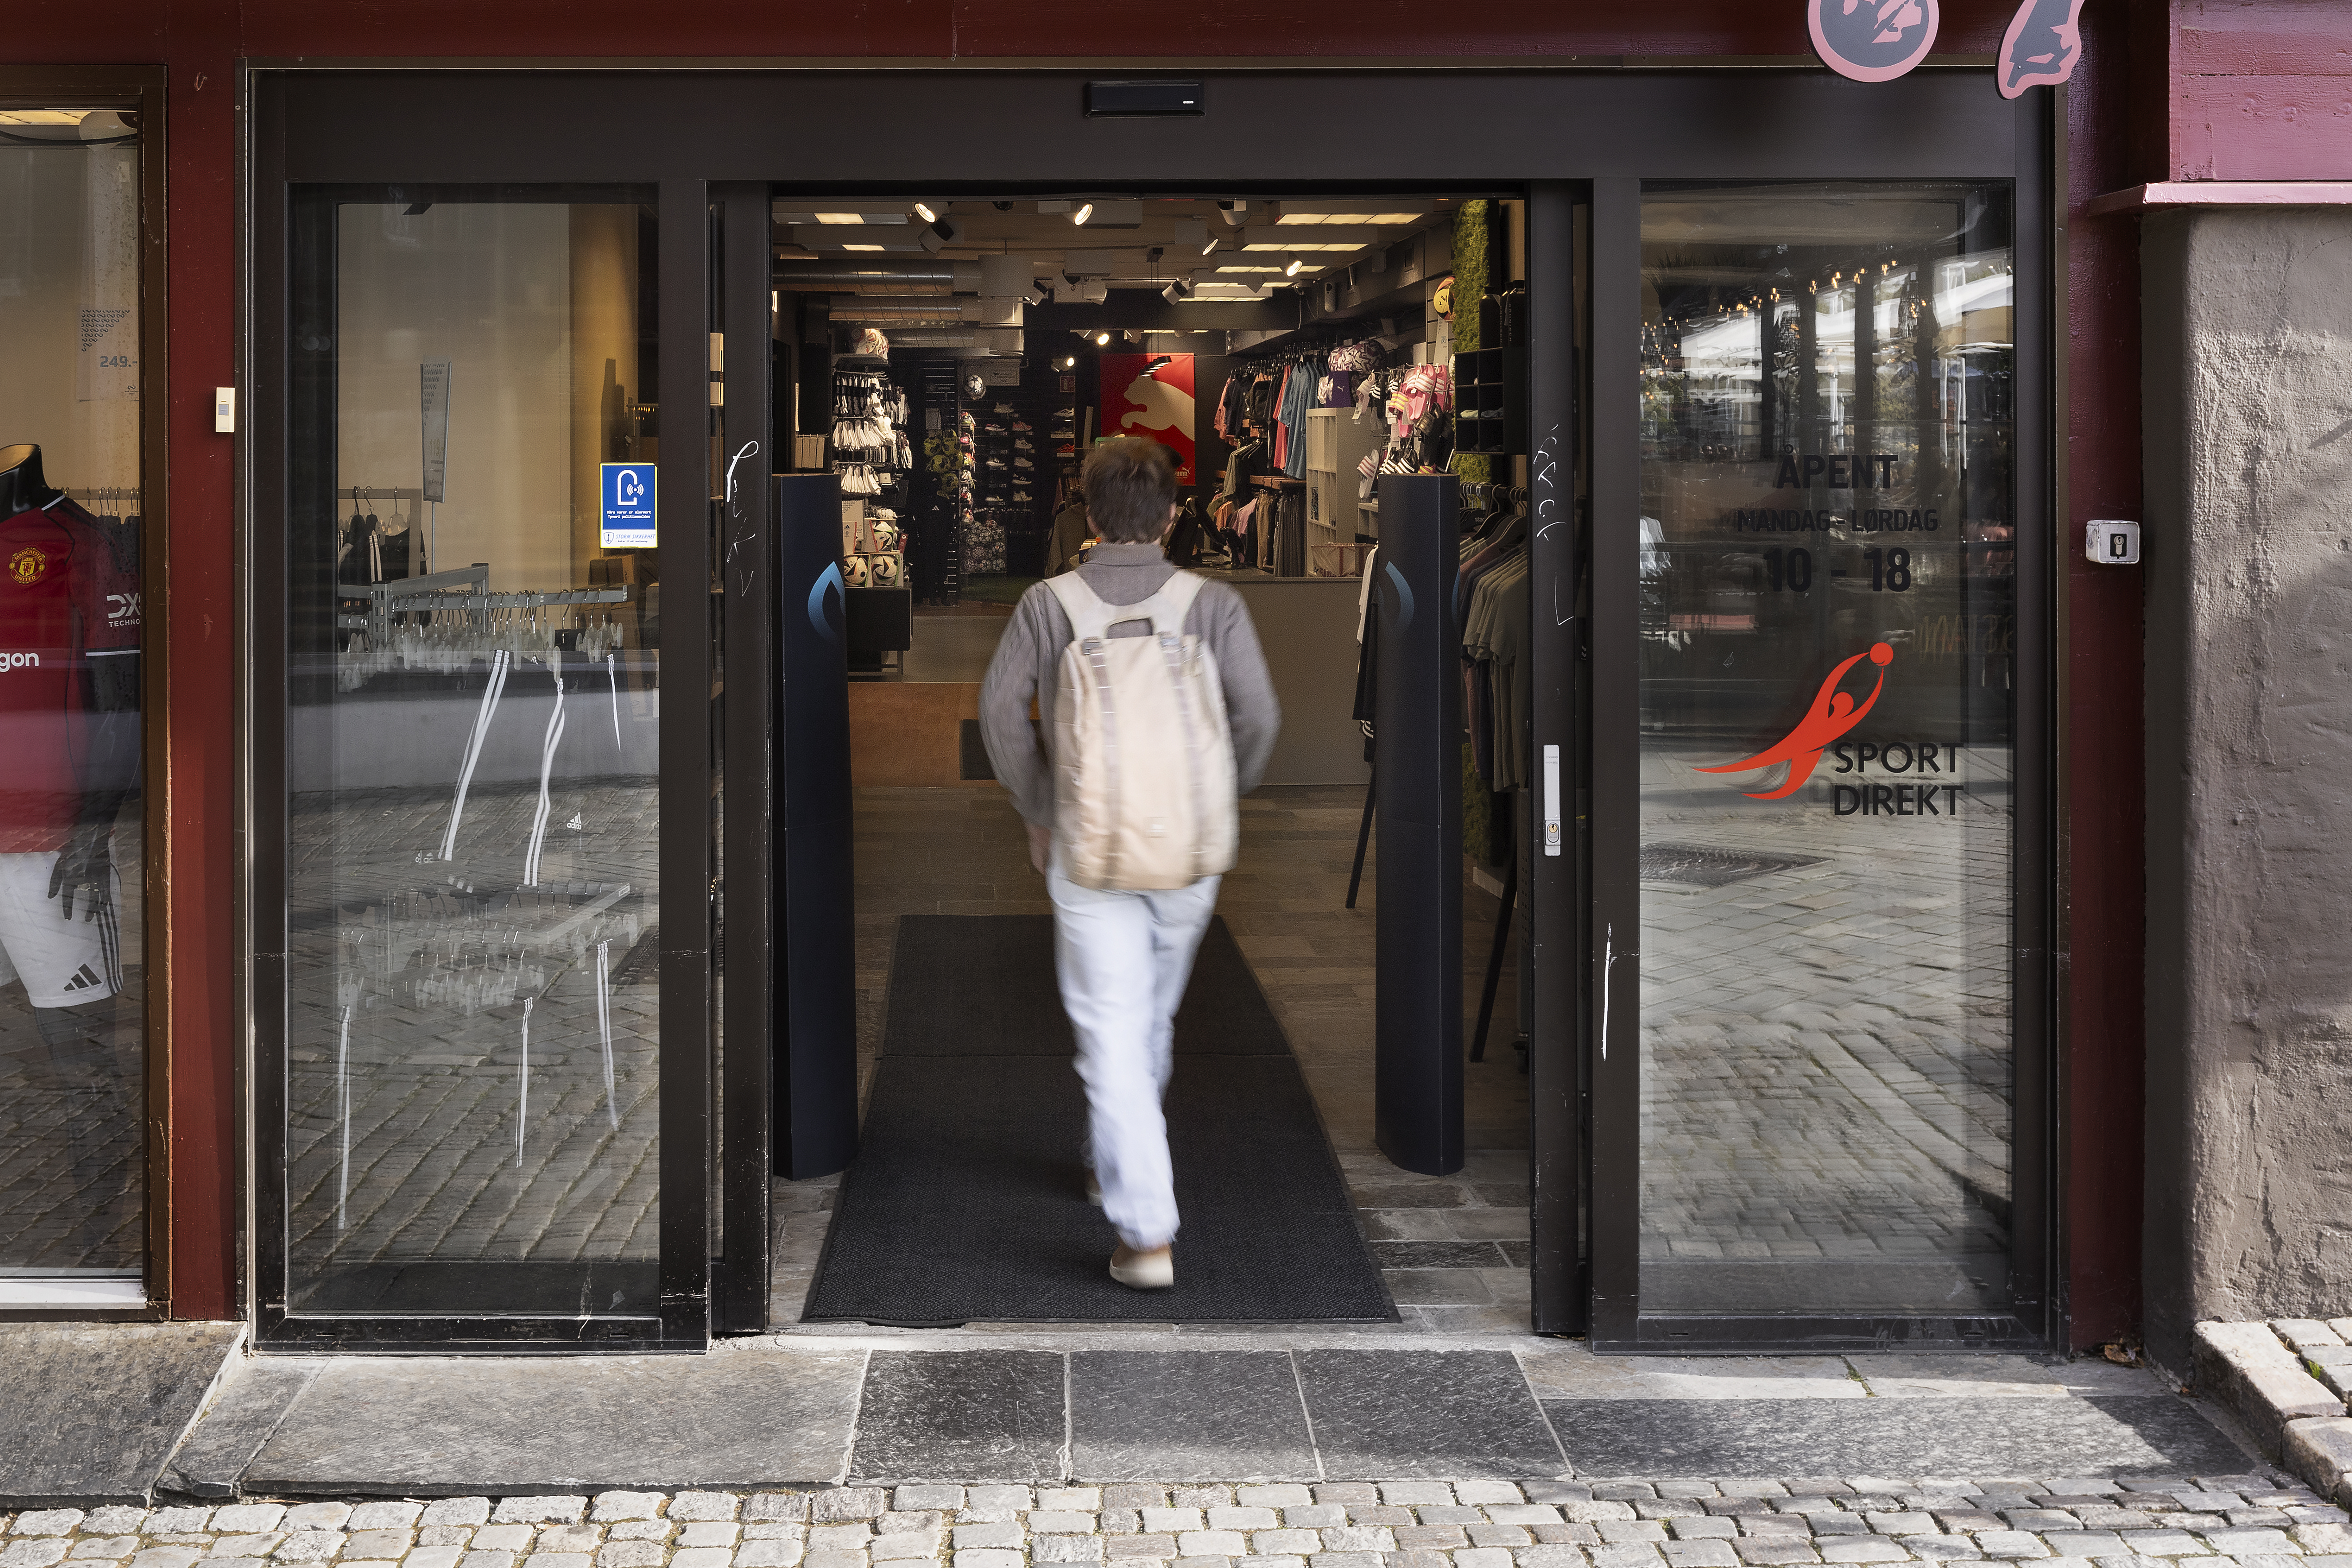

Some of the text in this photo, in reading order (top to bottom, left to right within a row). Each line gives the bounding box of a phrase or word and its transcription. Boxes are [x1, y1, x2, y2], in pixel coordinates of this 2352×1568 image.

[100, 356, 137, 368] 249.-
[1776, 444, 1899, 489] ÅPENT
[1737, 509, 1830, 532] MANDAG
[1851, 508, 1938, 534] LØRDAG
[14, 550, 43, 562] MANCHESTER
[1765, 547, 1812, 592] 10
[1863, 547, 1912, 593] 18
[1834, 742, 1964, 773] SPORT
[1834, 785, 1964, 816] DIREKT
